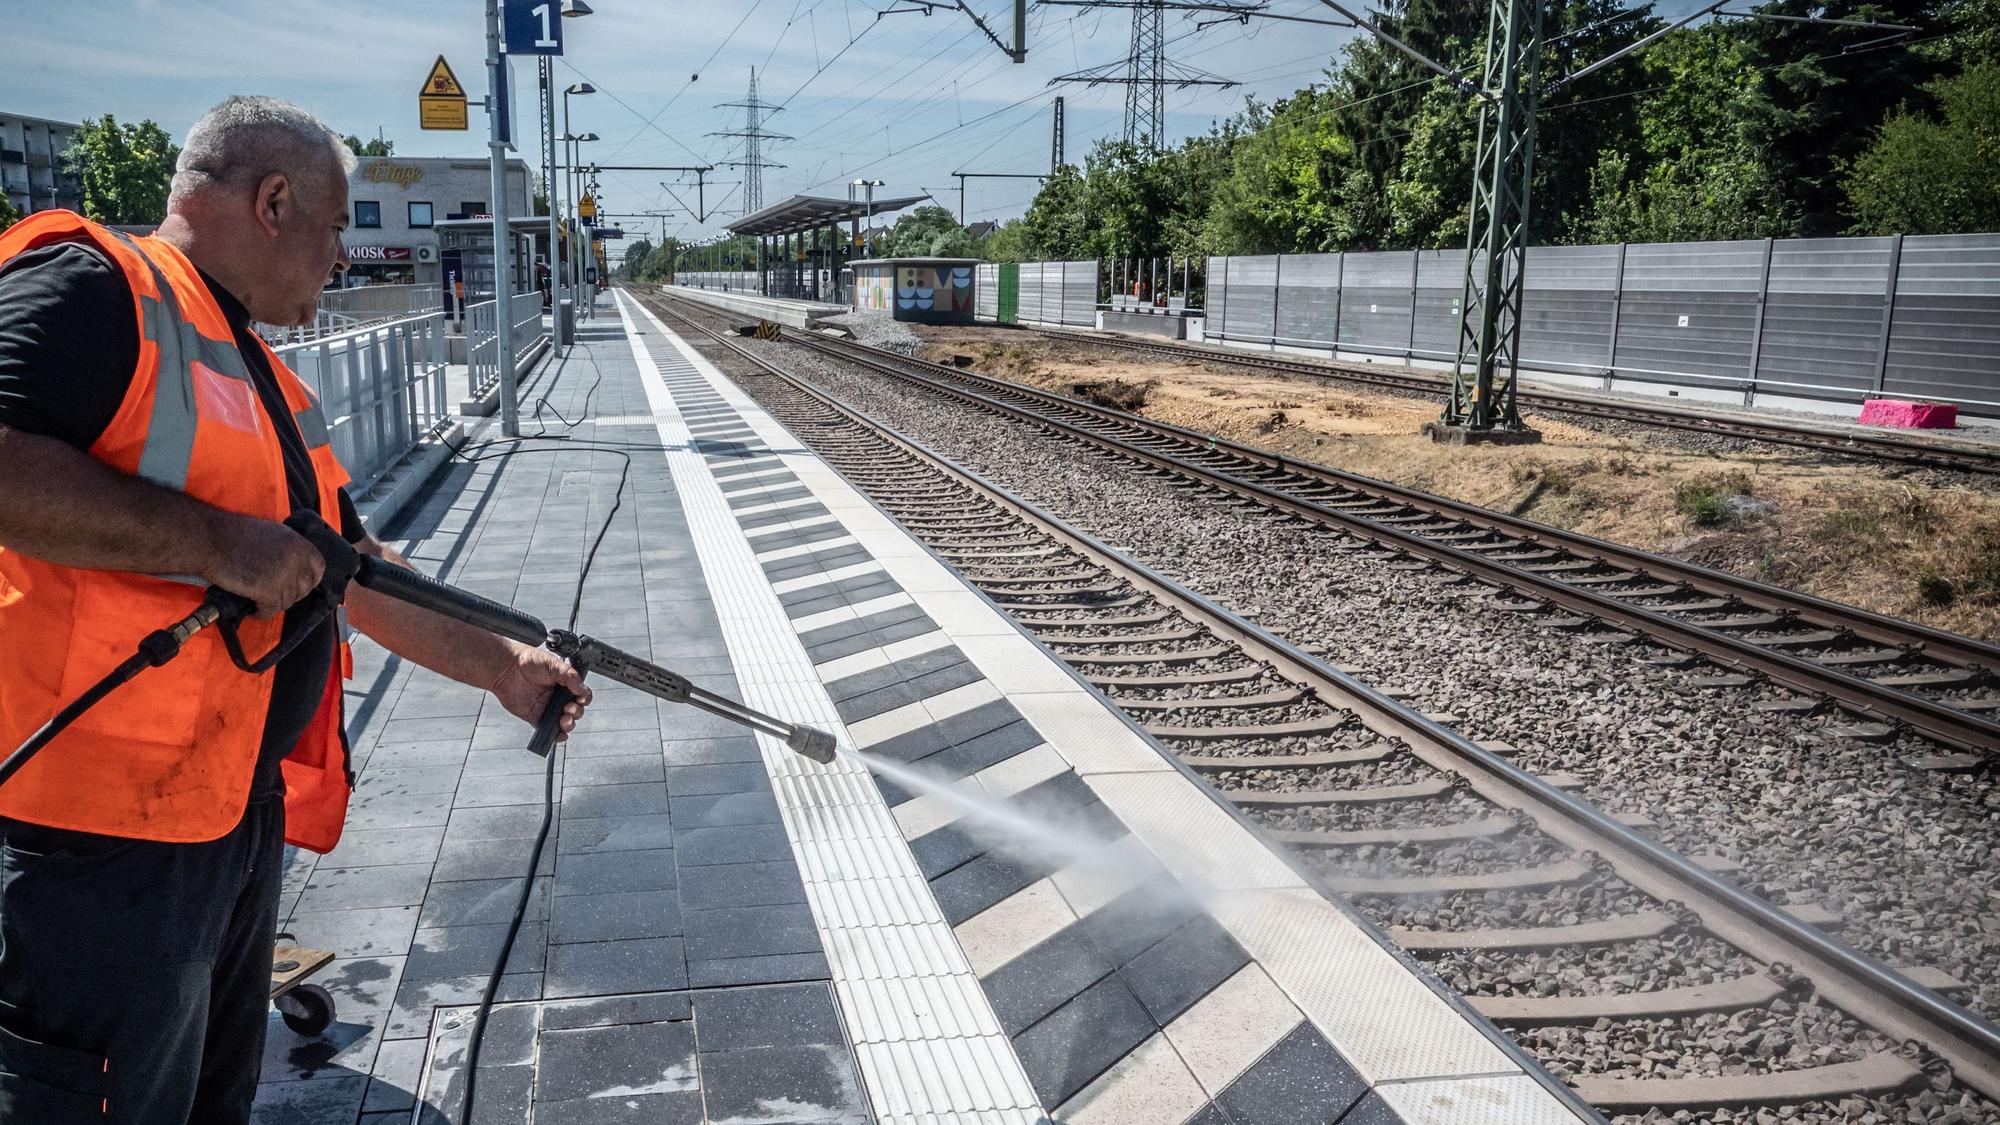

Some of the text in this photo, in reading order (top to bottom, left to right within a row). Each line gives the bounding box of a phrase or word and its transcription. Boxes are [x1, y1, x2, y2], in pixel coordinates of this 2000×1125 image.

[532, 4, 557, 47] 1
[349, 246, 385, 259] KIOSK
[842, 246, 848, 255] 2
